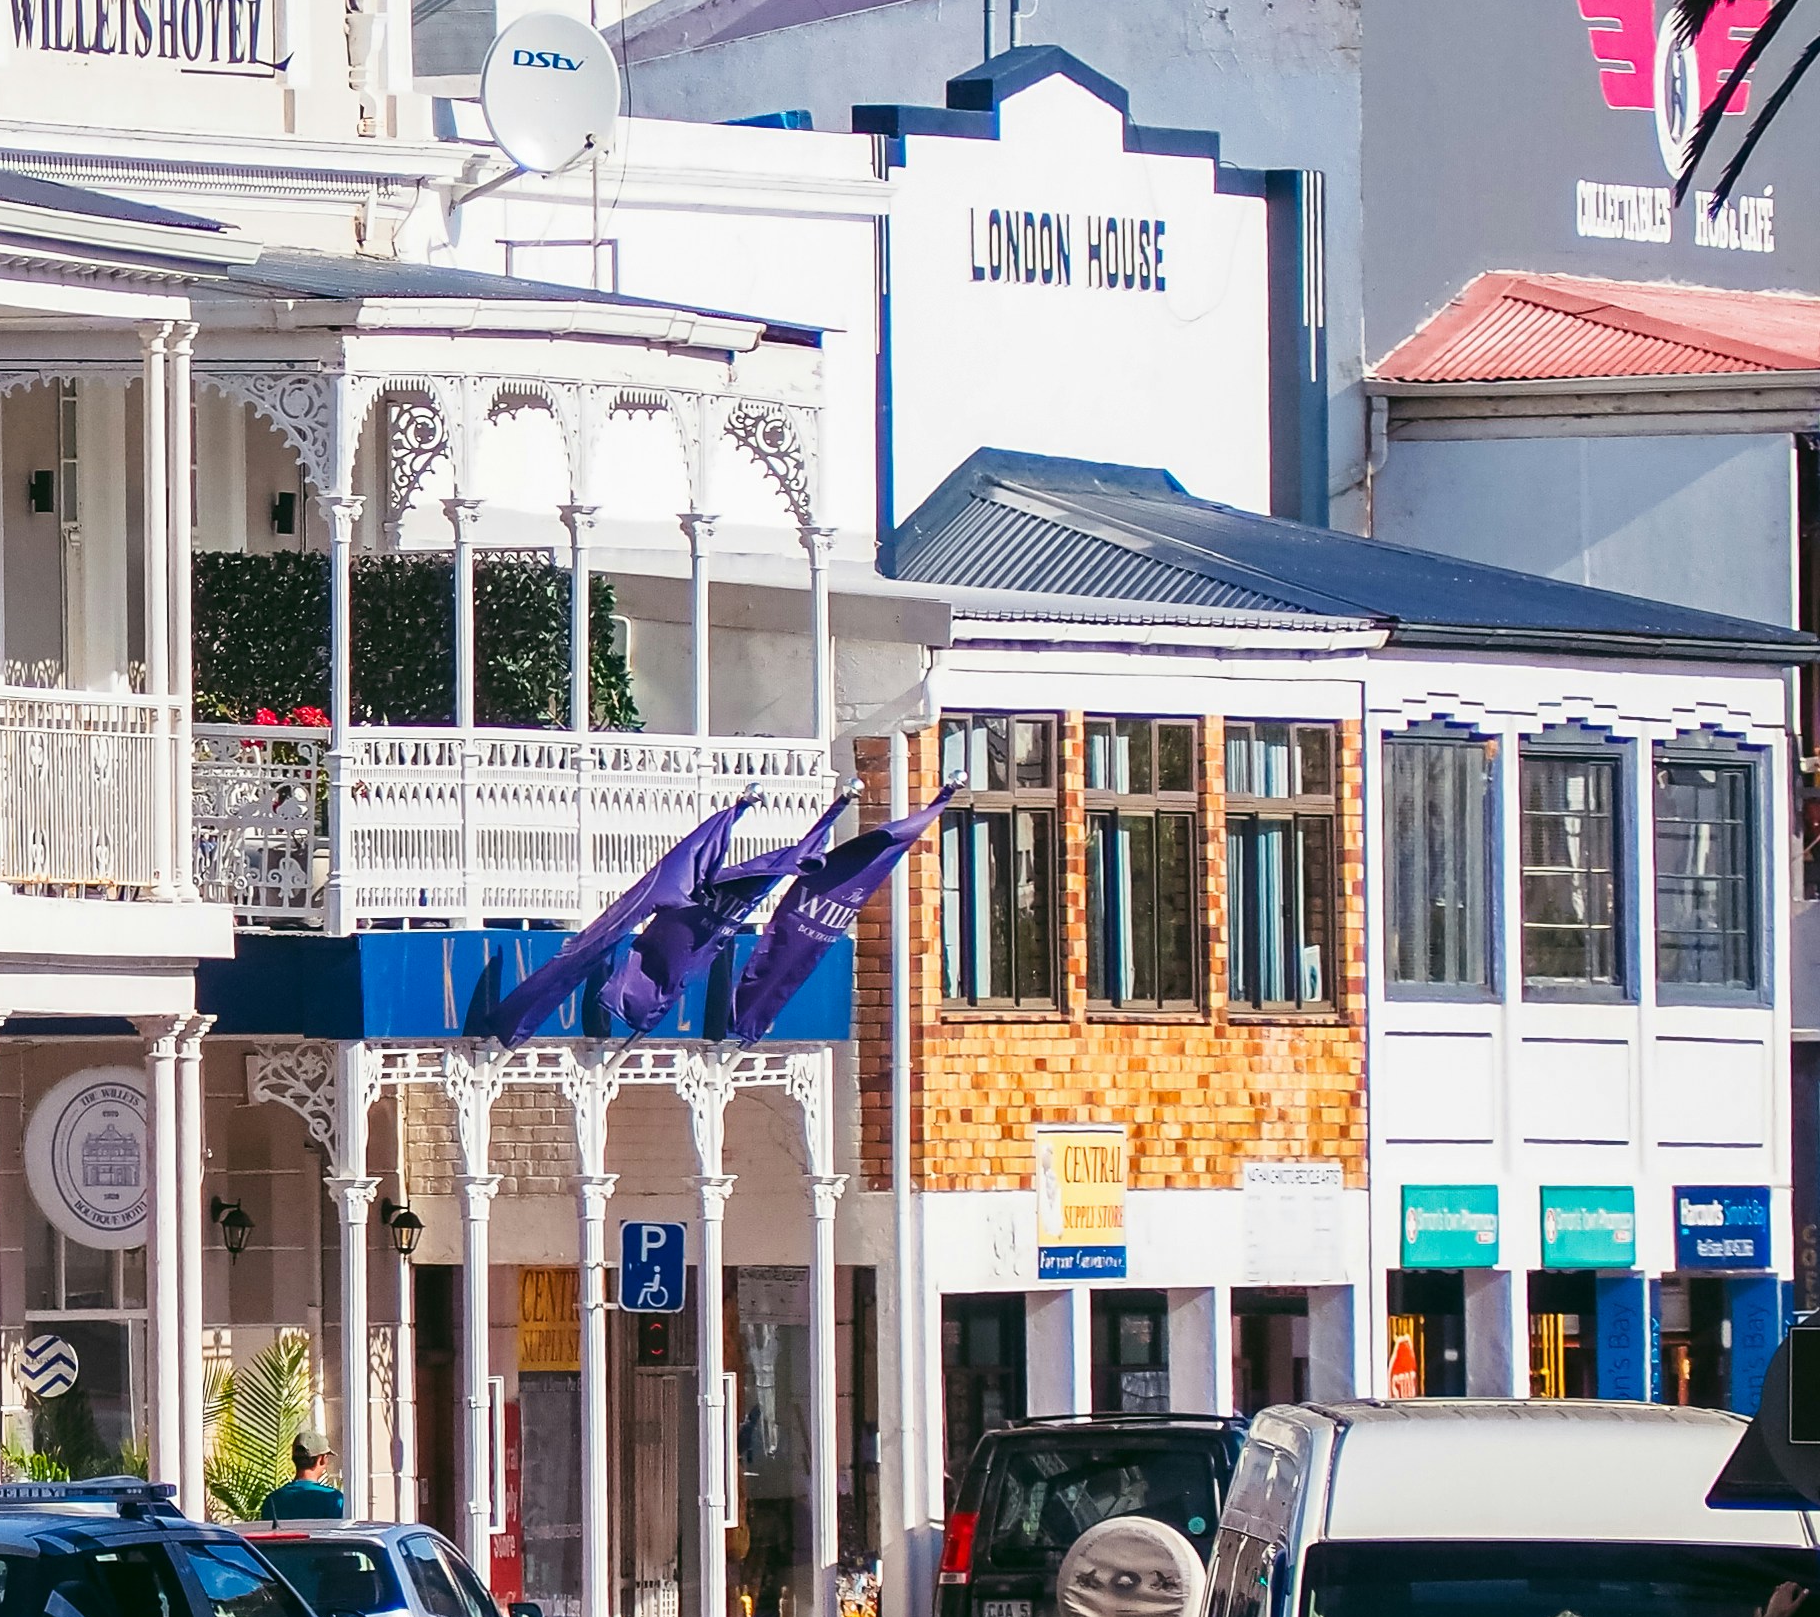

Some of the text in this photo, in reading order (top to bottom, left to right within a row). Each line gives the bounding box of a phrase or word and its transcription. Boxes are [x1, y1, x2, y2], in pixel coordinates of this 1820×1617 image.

[1576, 179, 1671, 244] COLLECTABLES
[969, 207, 1167, 292] LONDON HOUSE
[101, 1088, 140, 1107] WILLETS
[1064, 1146, 1123, 1184] CENTRAL
[1064, 1204, 1124, 1229] SUPPLY STORE
[641, 1225, 667, 1262] P
